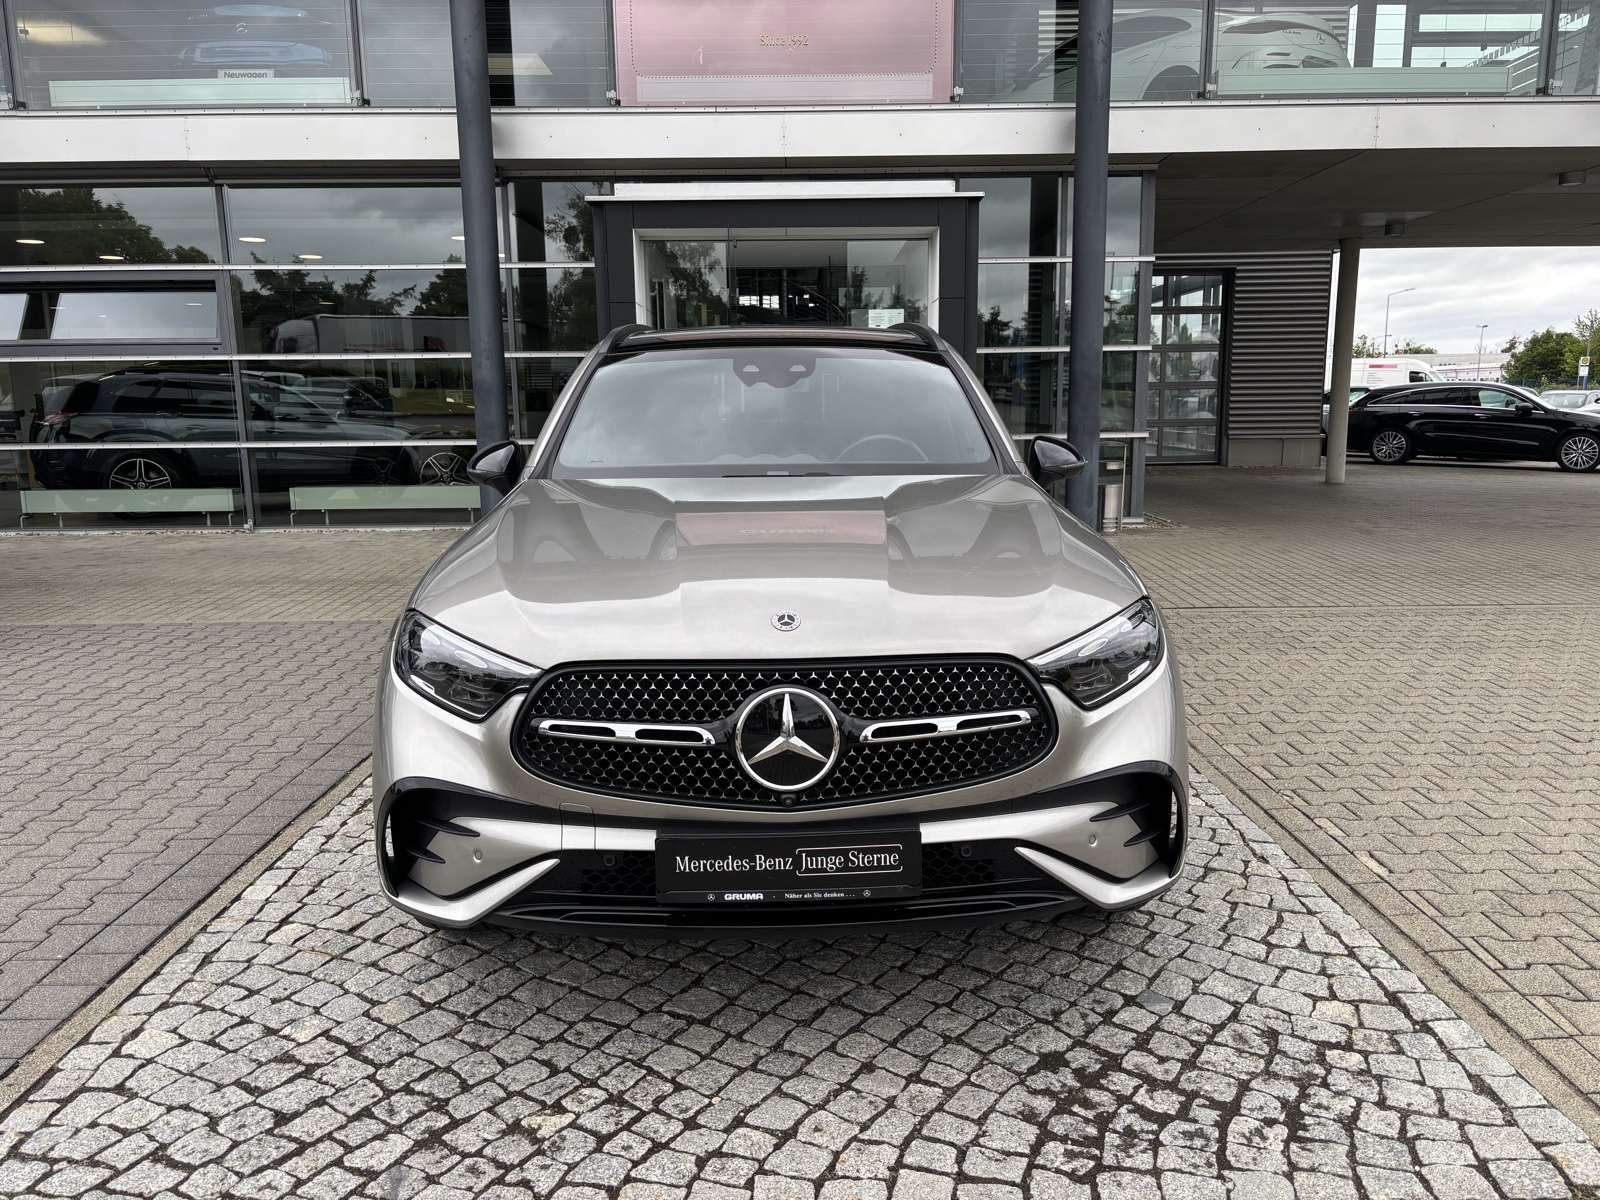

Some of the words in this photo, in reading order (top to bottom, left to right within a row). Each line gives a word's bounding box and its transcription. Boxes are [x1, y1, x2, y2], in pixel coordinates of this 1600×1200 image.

[760, 35, 786, 47] Since
[787, 35, 809, 47] 1992
[223, 71, 268, 79] Neuwagen
[675, 854, 794, 873] Mercedes-Benz
[800, 852, 845, 872] Junge
[848, 850, 899, 868] Sterne
[724, 892, 764, 900] GRUMA
